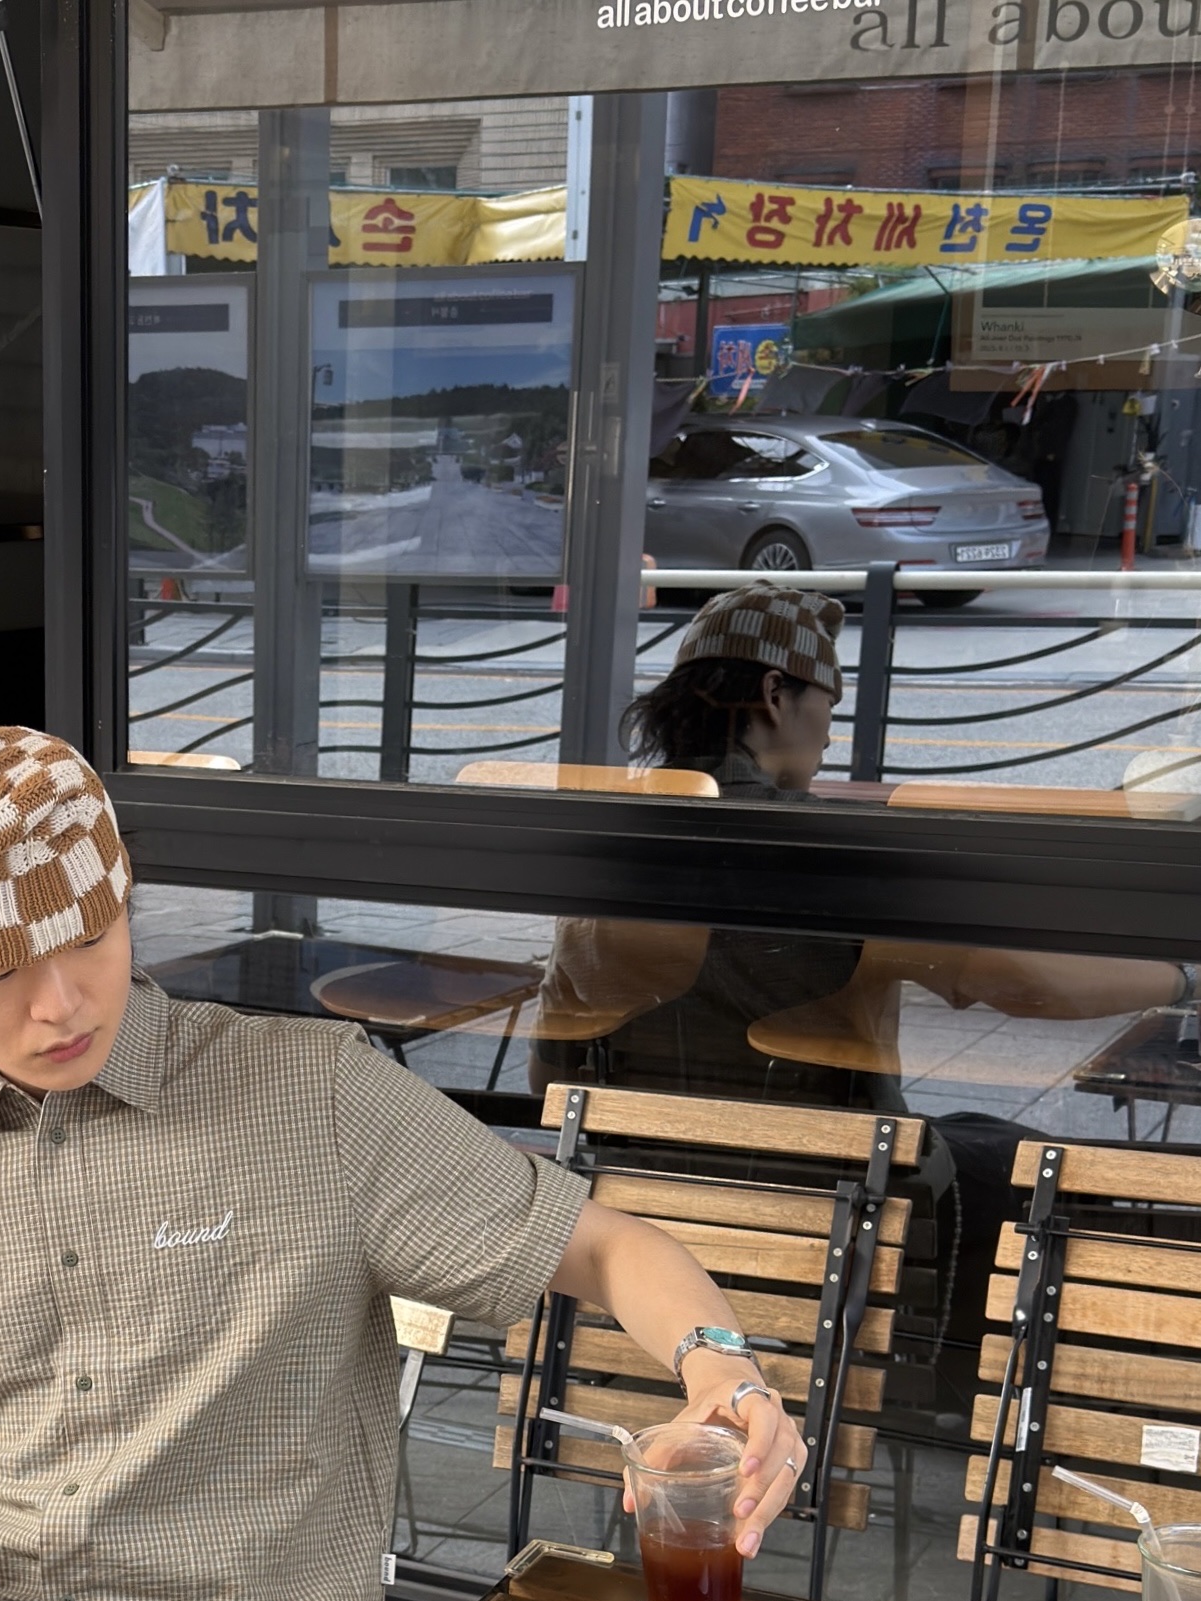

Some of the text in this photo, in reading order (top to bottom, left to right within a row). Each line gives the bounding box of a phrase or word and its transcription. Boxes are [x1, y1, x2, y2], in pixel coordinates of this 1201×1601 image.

[850, 0, 951, 50] all
[153, 1210, 234, 1249] bound
[382, 1556, 393, 1583] bound
